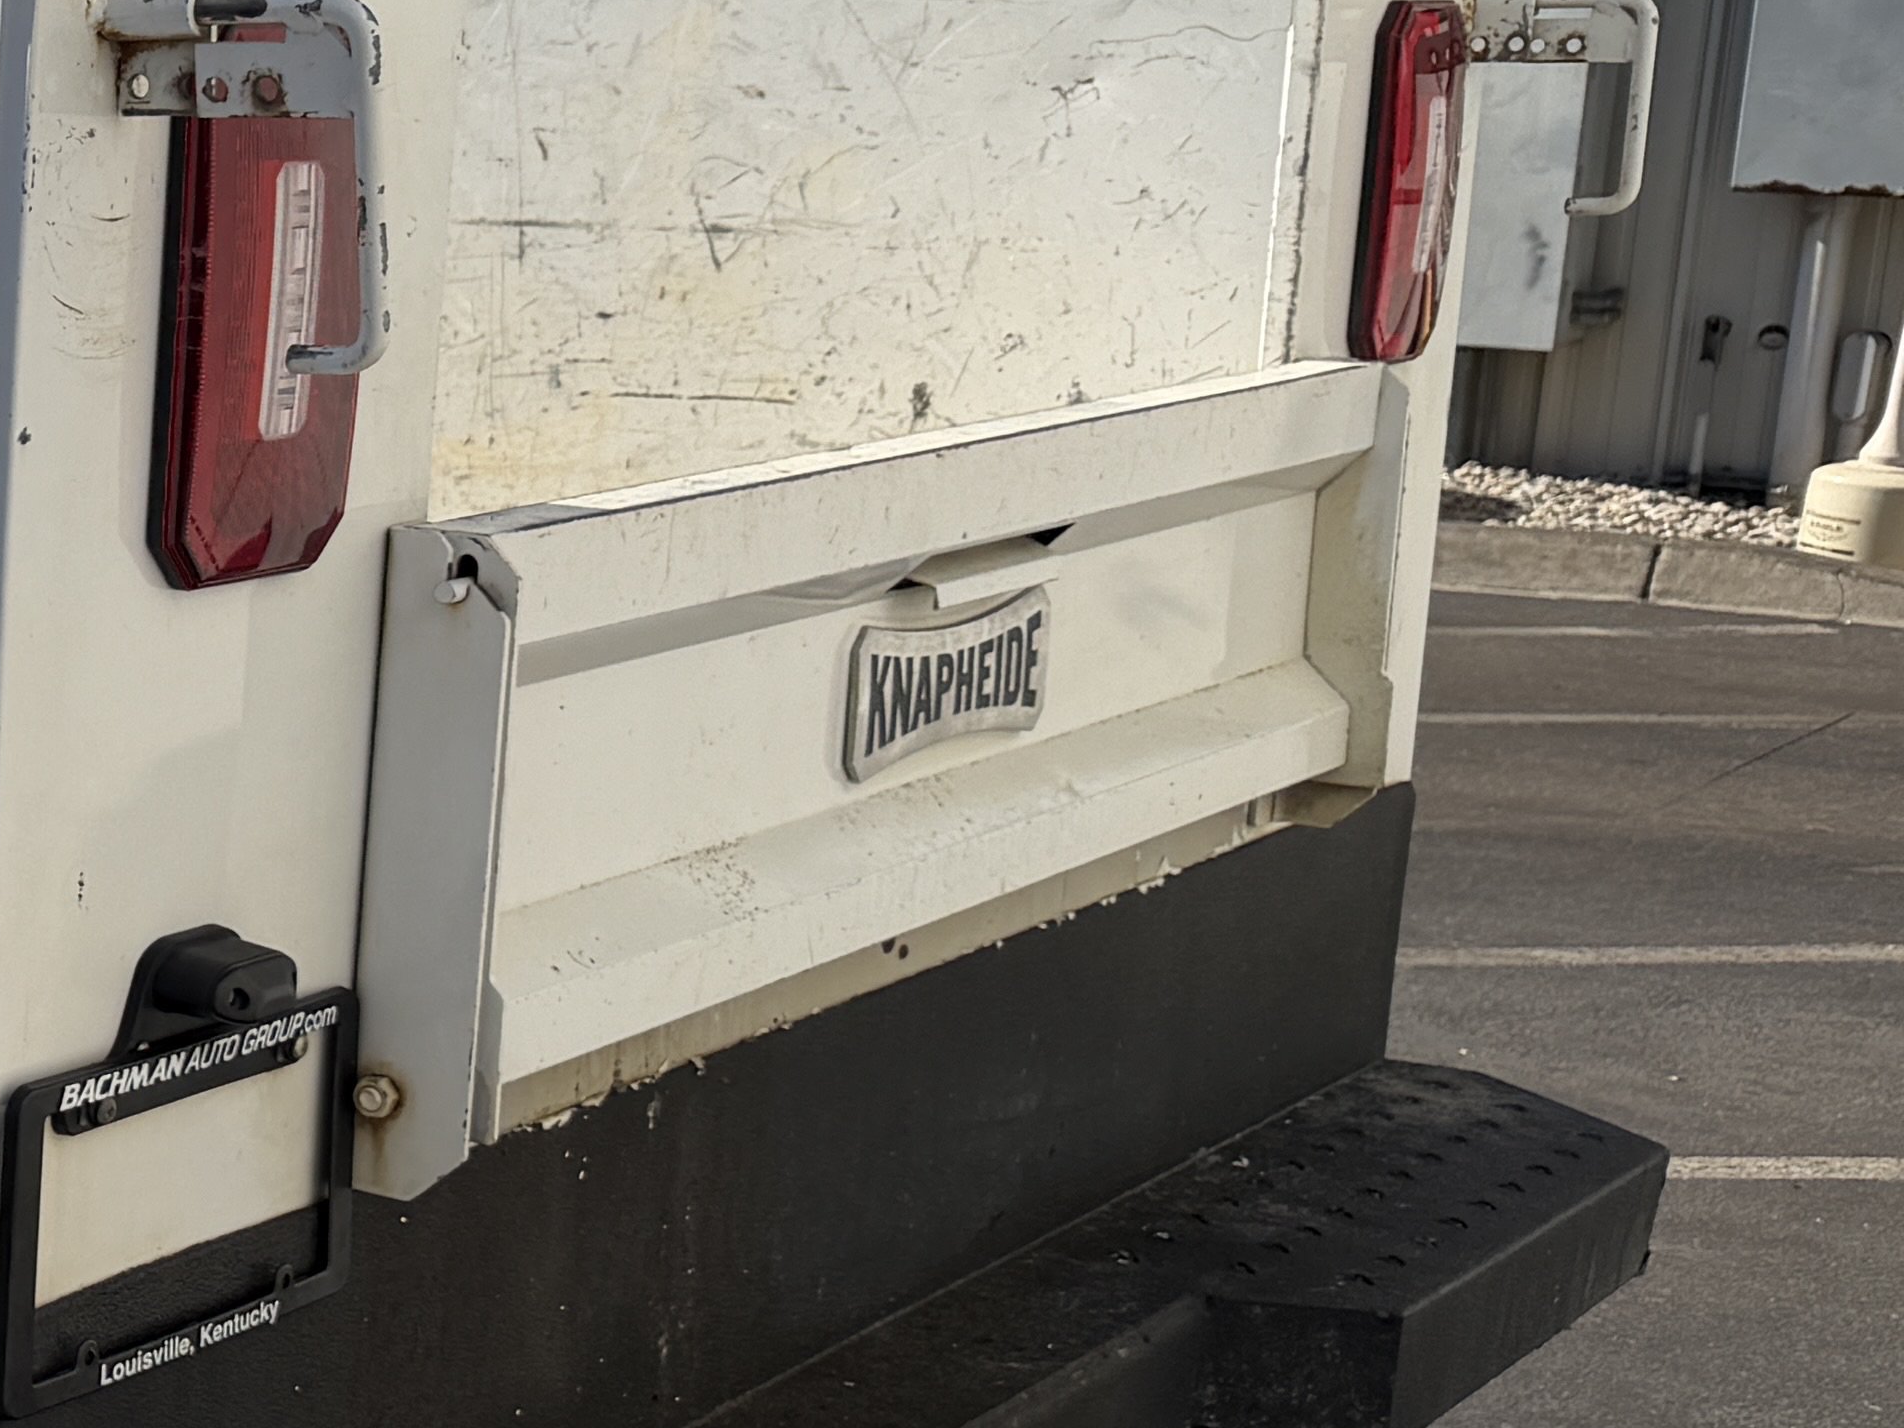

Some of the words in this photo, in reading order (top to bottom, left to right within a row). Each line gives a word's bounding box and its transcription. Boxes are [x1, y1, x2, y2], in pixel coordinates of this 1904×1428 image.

[864, 610, 1042, 757] KNAPHEIDE
[60, 1052, 187, 1111] BACHMAN
[185, 1034, 239, 1074] AUTO
[242, 1006, 338, 1055] GROUP.com
[100, 1336, 195, 1386] Louisville,
[200, 1300, 279, 1348] Kentucky
